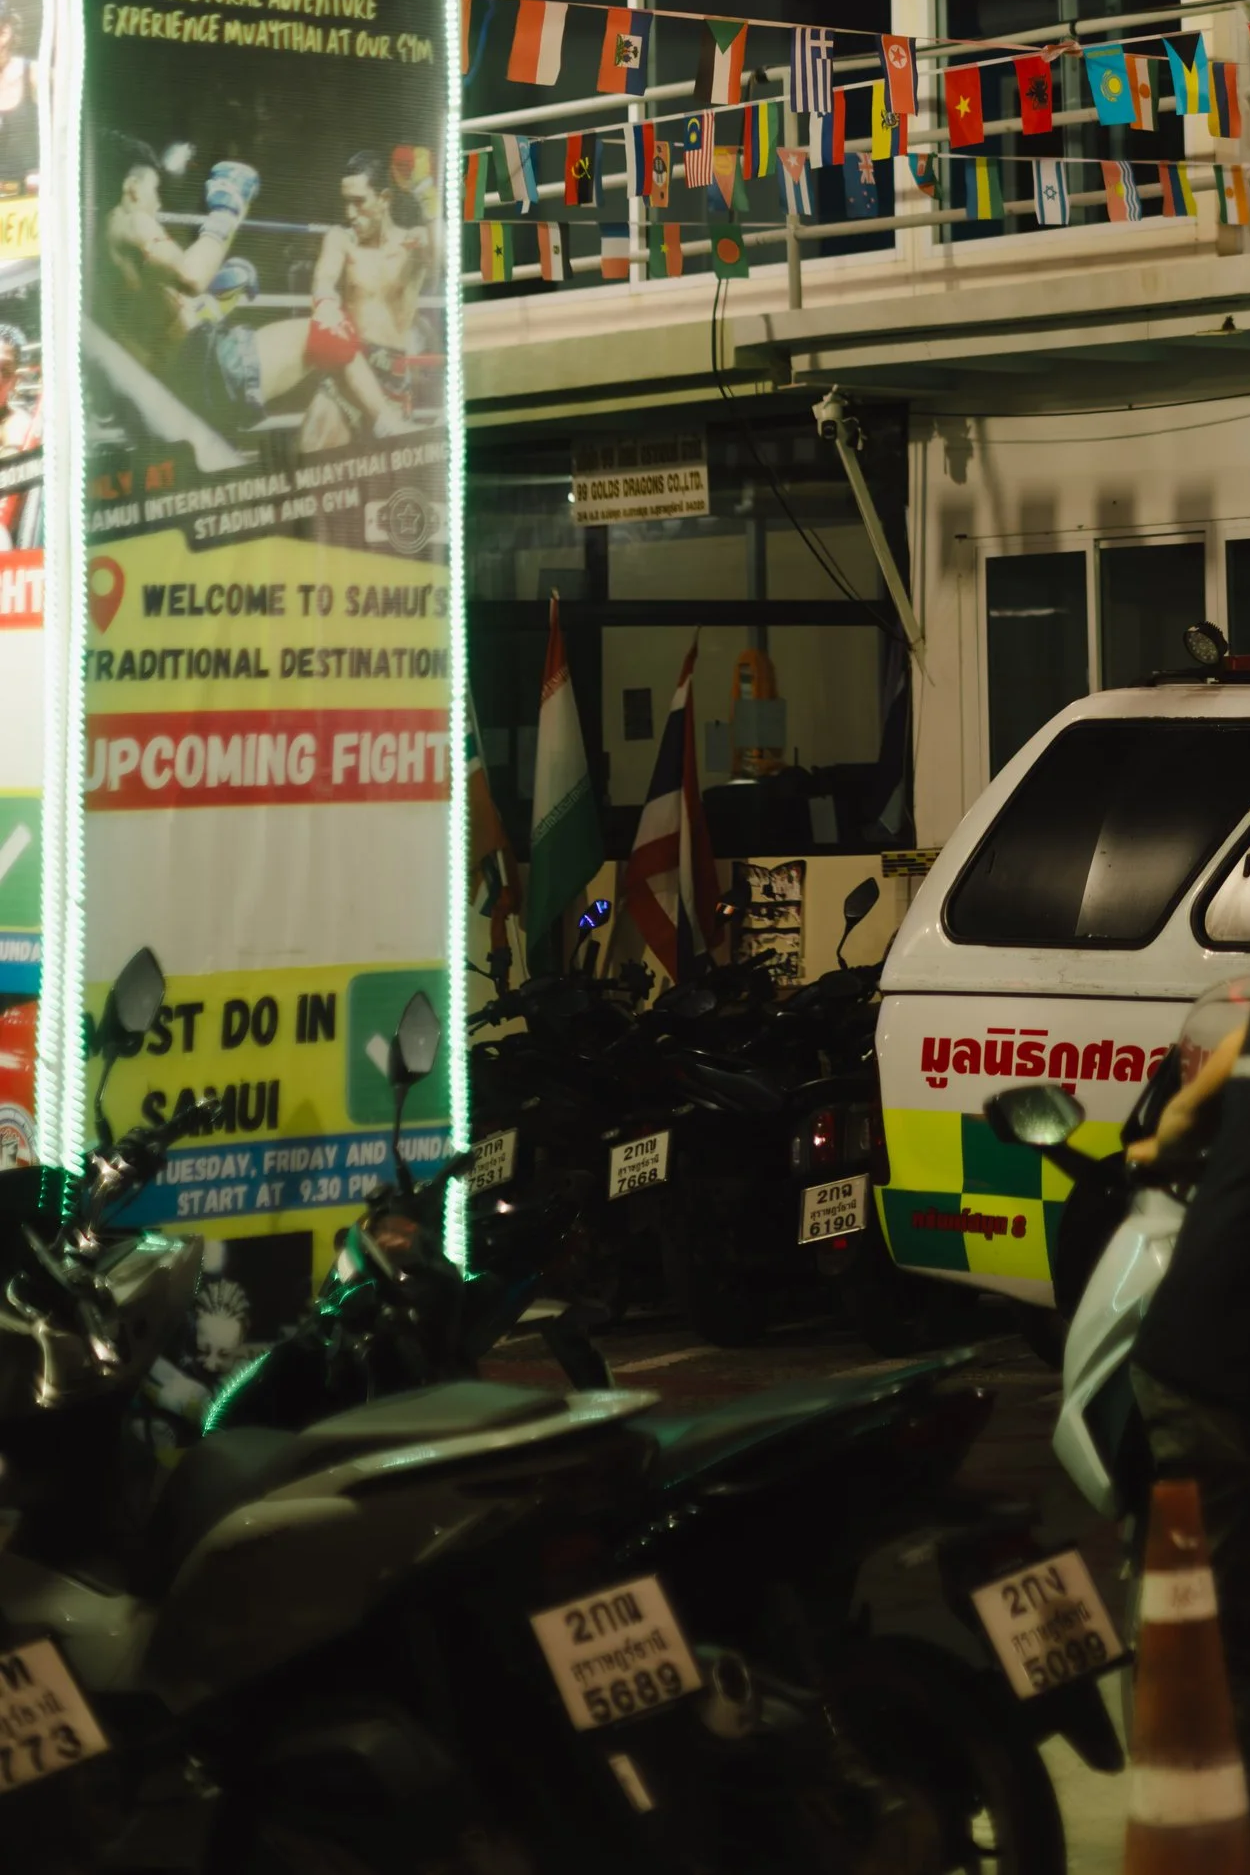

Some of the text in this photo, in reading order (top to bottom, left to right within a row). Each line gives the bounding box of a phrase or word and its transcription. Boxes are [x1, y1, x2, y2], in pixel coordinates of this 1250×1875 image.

[224, 18, 324, 54] MUAYTHAI
[326, 28, 353, 56] AT
[355, 30, 394, 60] OUR
[396, 32, 434, 63] GYM
[87, 504, 140, 533] AMUI
[144, 471, 291, 521] INTERNATIONAL
[296, 451, 387, 491] MUAYTHAI
[576, 482, 588, 502] 99
[591, 477, 620, 501] GOLDS
[622, 474, 665, 497] DRAGONS
[194, 486, 360, 541] STADIUM AND GYM
[142, 581, 448, 618] WELCOME TO SAMUI'S
[279, 645, 450, 680] DESTINATION
[331, 729, 451, 786] FIGHT
[221, 992, 337, 1052] DO IN
[263, 1145, 340, 1176] FRIDAY
[346, 1139, 387, 1167] AND
[177, 1182, 249, 1218] START
[255, 1180, 286, 1208] AT
[299, 1175, 342, 1204] 9.30
[468, 1167, 504, 1192] 7531
[617, 1167, 659, 1193] 7668
[809, 1212, 856, 1237] 6190
[582, 1661, 683, 1725] 5689
